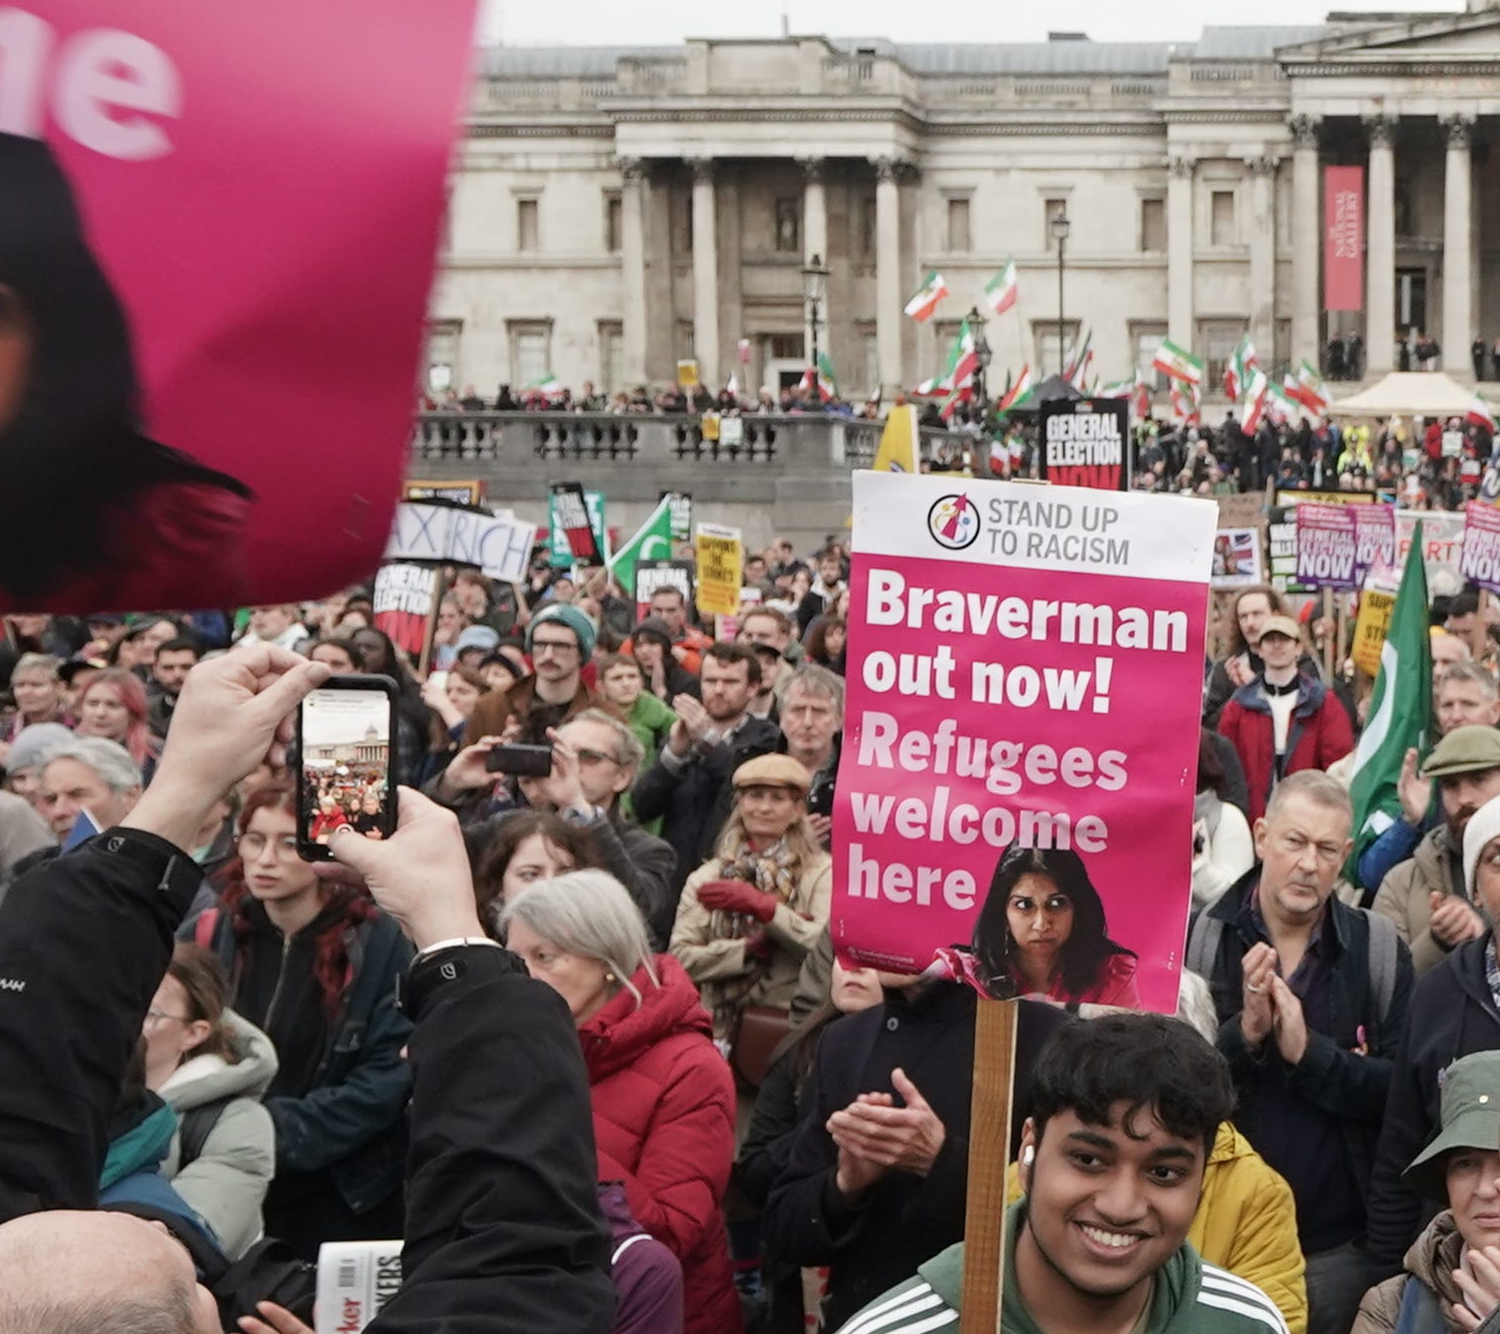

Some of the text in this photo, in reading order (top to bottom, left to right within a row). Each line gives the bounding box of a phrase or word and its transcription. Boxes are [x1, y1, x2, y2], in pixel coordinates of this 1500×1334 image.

[1046, 414, 1122, 441] GENERAL
[1046, 440, 1122, 466] ELECTION
[452, 513, 533, 576] RICH
[987, 528, 1131, 565] TO RACISM
[989, 498, 1119, 533] STAND UP
[1299, 553, 1353, 579] NOW
[866, 568, 1188, 653] Braverman
[862, 645, 1114, 713] out now!
[857, 711, 1128, 795] Refugees
[850, 786, 1109, 853] welcome
[848, 843, 977, 910] here
